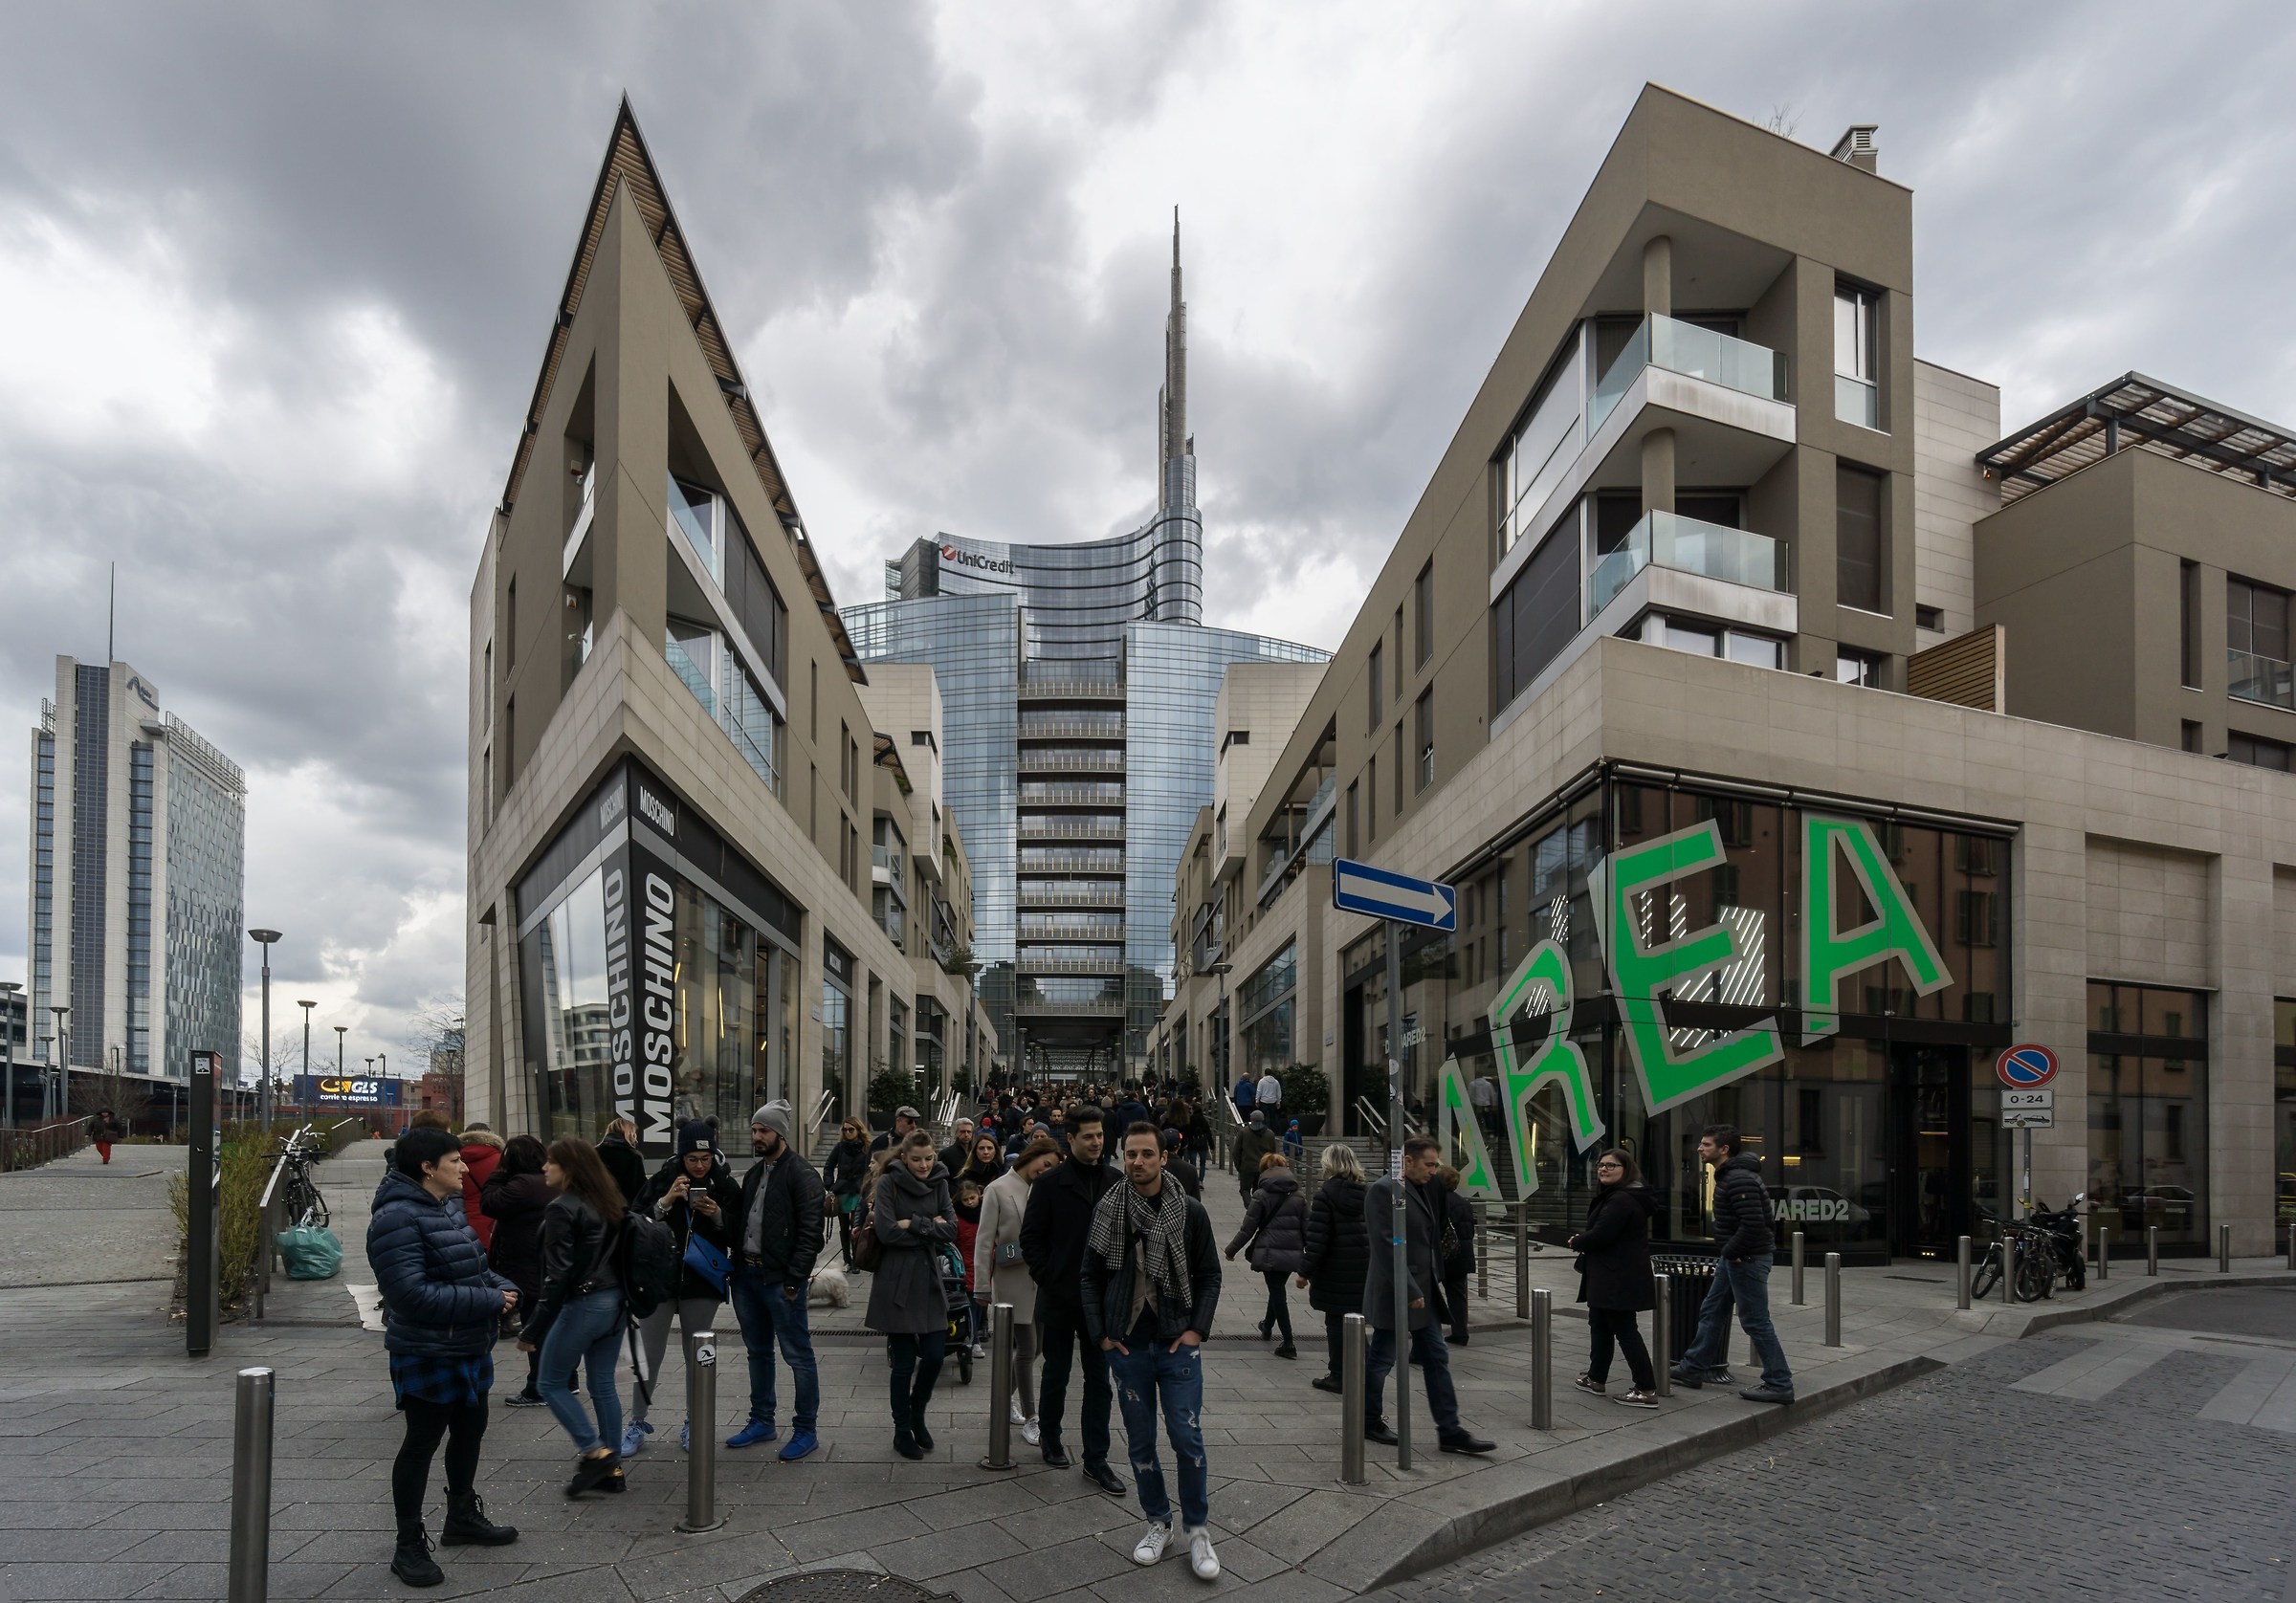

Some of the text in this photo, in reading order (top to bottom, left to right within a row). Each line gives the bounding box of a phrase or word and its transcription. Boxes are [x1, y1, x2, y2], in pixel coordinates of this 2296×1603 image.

[958, 550, 1014, 574] UniCredit
[639, 785, 674, 837] MOSCHINO
[643, 872, 674, 1143] MOSCHINO
[1384, 1025, 1426, 1055] DARED2
[351, 1081, 379, 1095] GLS
[1770, 1198, 1849, 1221] ARED2
